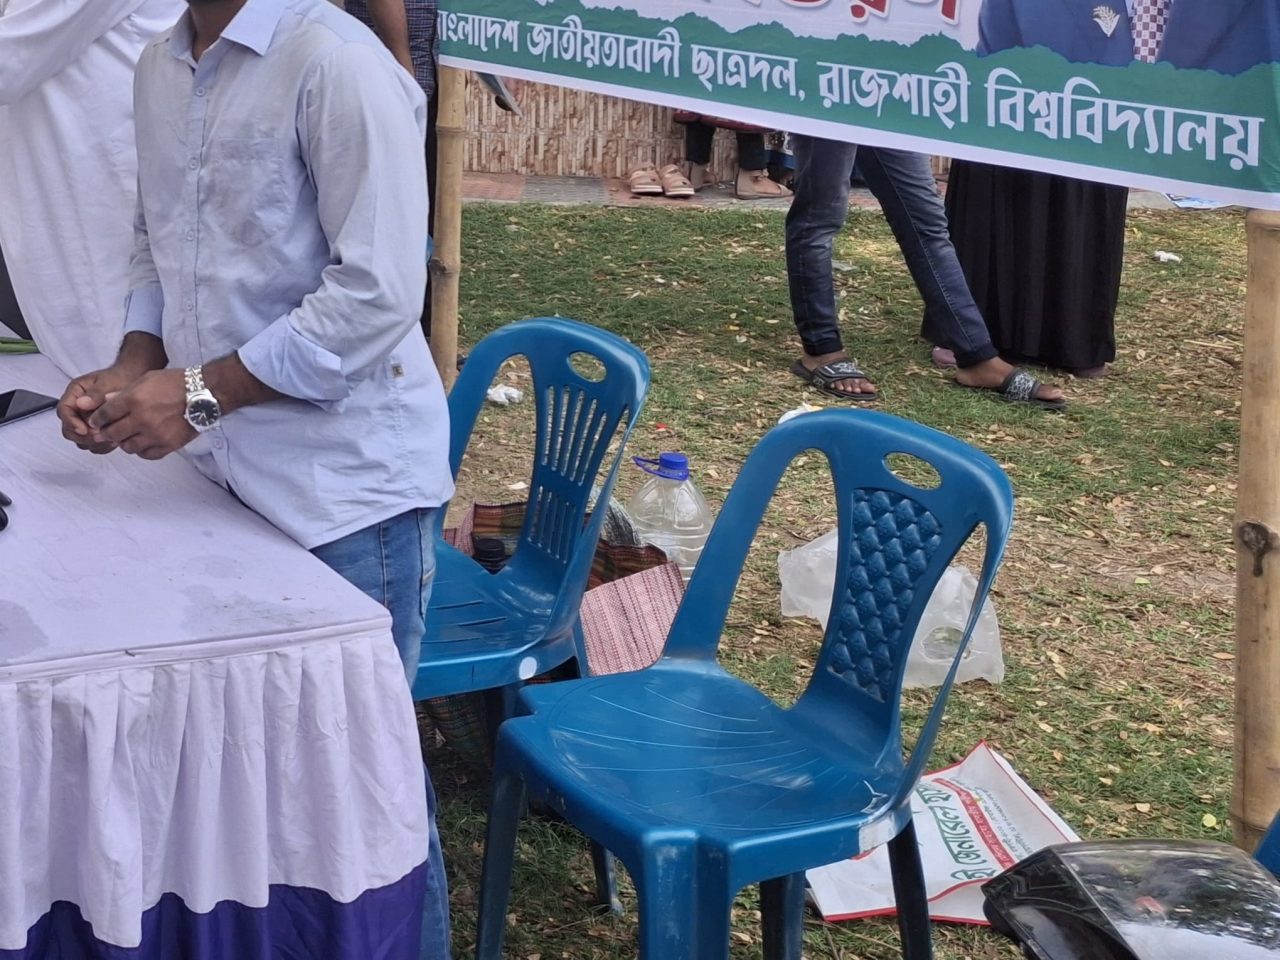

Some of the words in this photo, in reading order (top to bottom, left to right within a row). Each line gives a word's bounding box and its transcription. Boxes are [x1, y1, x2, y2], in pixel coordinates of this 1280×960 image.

[437, 10, 520, 52] াংলাদেশ
[526, 14, 682, 79] জাতীয়তাবাদী
[691, 43, 806, 102] ছাত্রদল,
[816, 61, 972, 129] রাজশাহী
[984, 67, 1265, 171] বিশ্ববিদ্যালয়
[928, 805, 987, 865] জেনারেল
